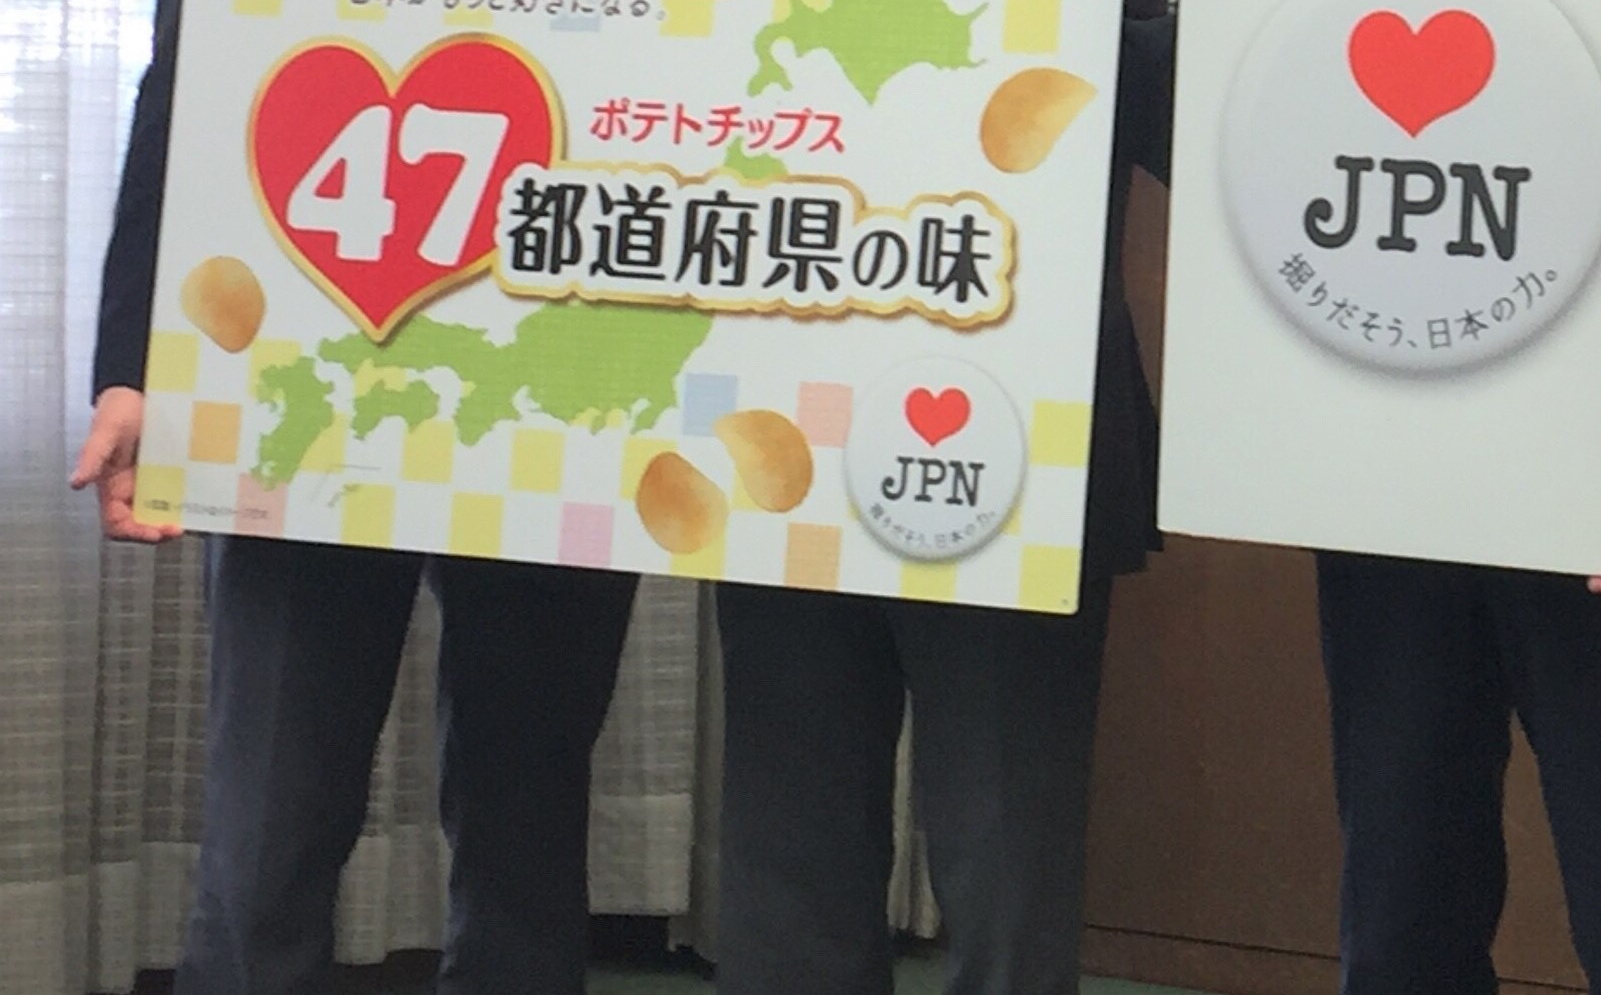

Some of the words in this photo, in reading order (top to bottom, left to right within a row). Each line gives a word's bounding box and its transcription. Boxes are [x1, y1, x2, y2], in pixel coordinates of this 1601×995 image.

[588, 101, 847, 155] ポテトチップス
[287, 101, 511, 269] 47
[1302, 154, 1533, 263] JPN
[507, 177, 997, 304] 都道府県の味
[1277, 251, 1559, 351] 掘りだそう、日本の力。
[881, 455, 986, 508] JPN
